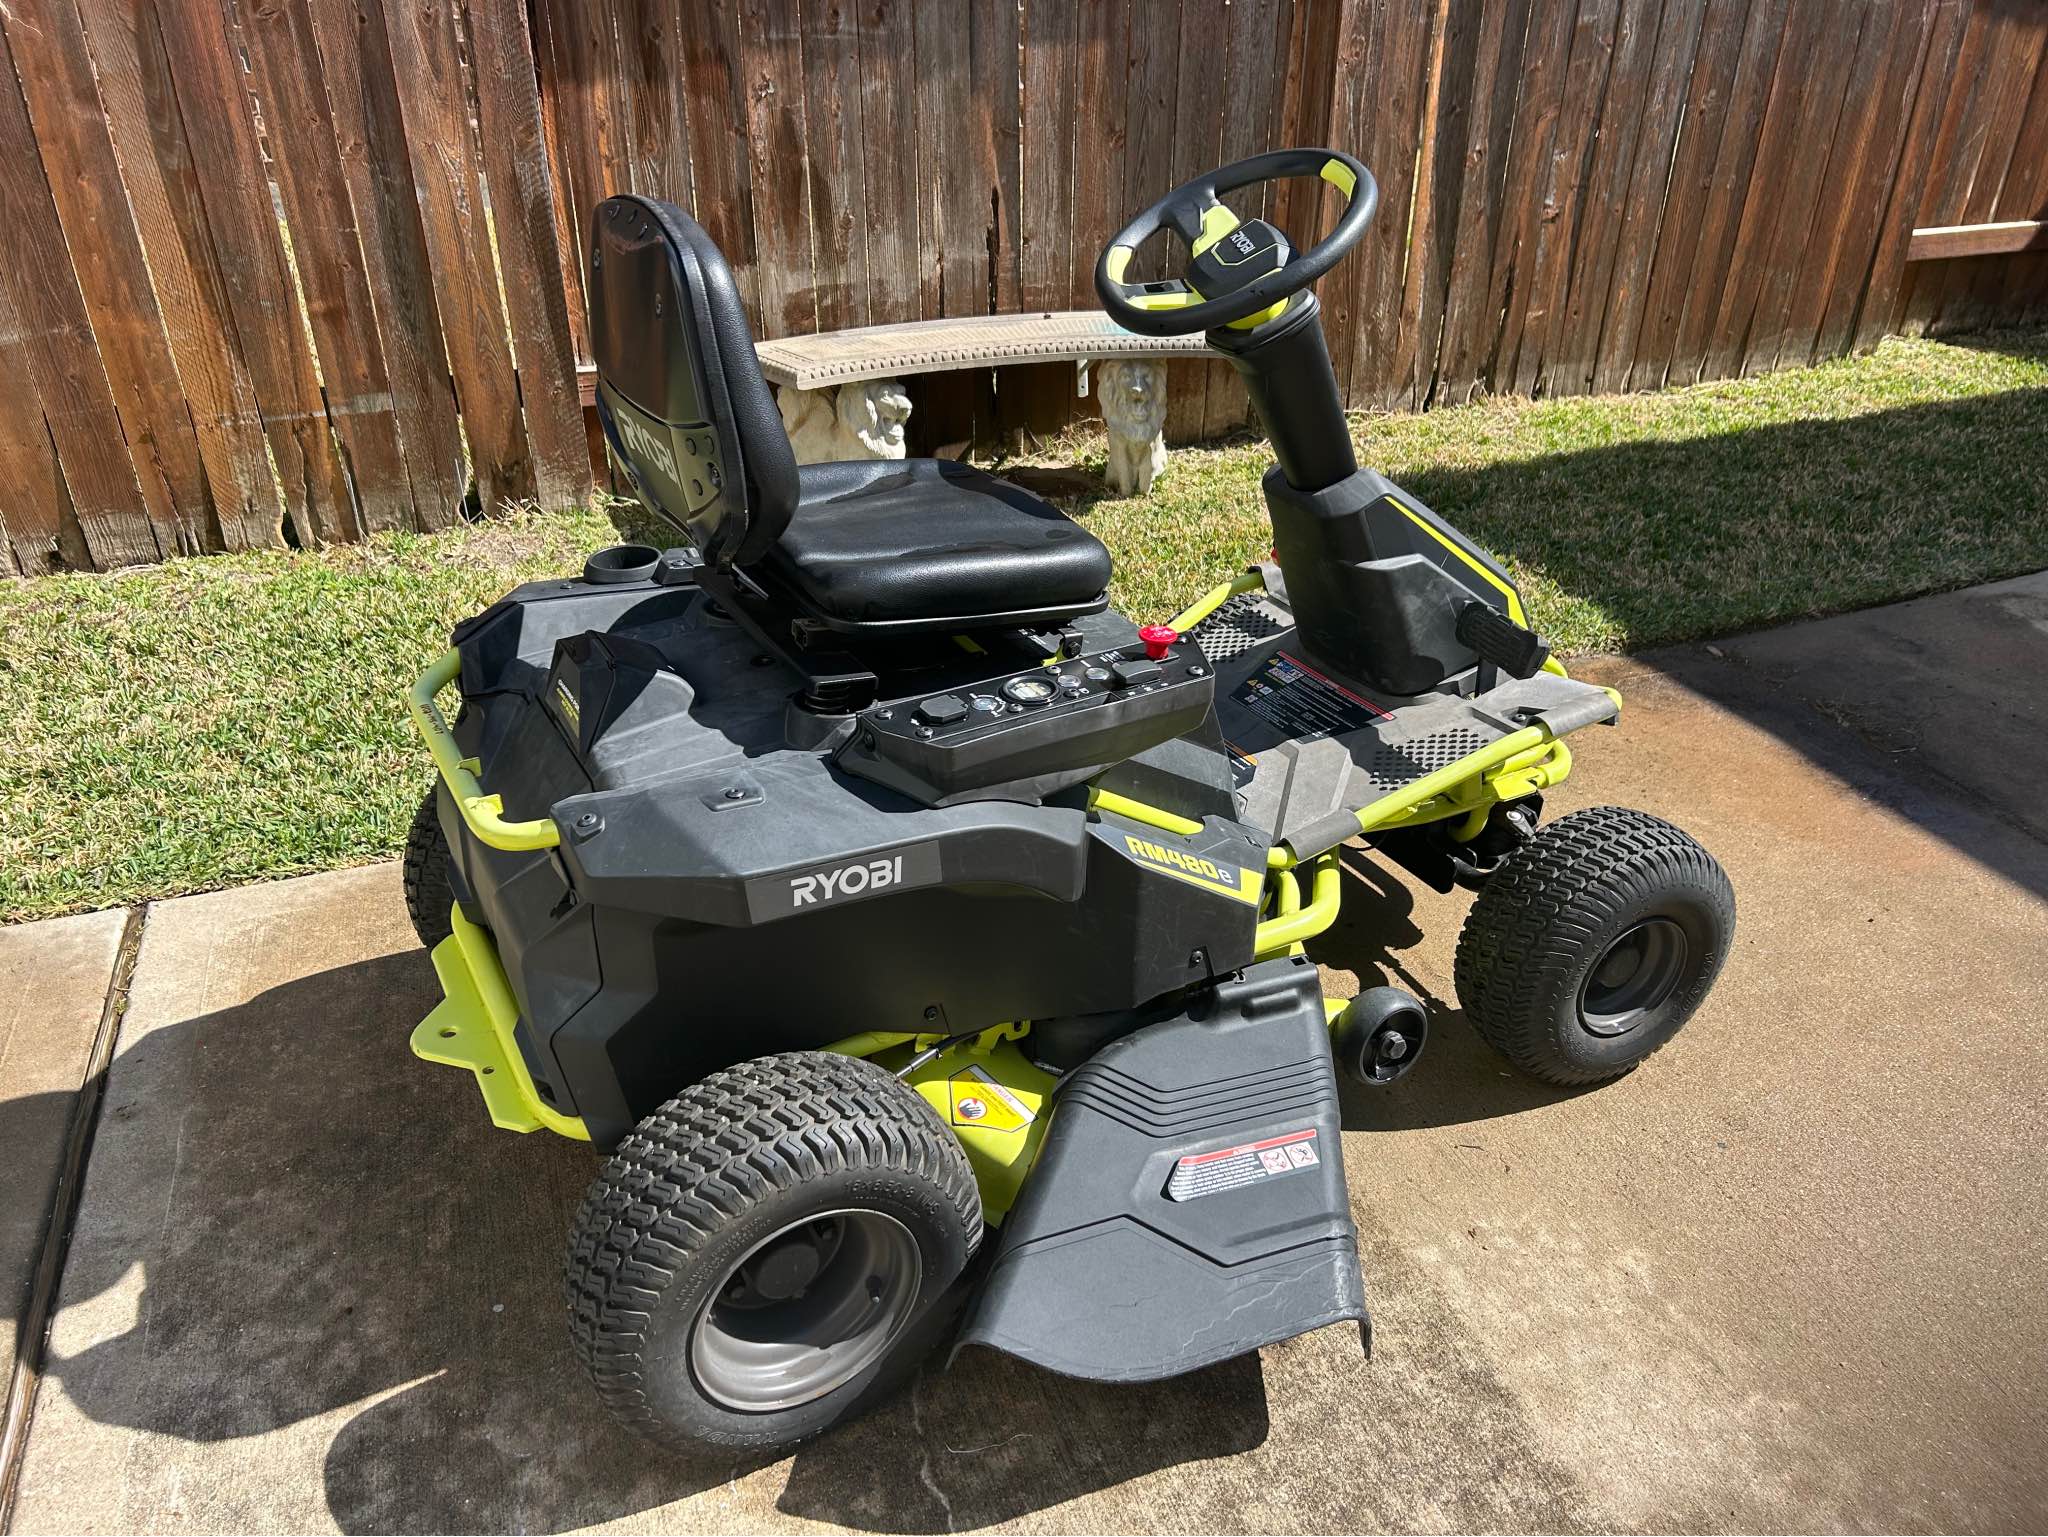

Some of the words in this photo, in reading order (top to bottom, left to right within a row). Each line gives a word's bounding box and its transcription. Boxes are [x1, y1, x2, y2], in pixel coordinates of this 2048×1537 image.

[1229, 229, 1256, 255] RYOBI
[615, 407, 679, 484] RYOBI
[790, 855, 903, 907] RYOBI
[1124, 835, 1234, 884] RM480e
